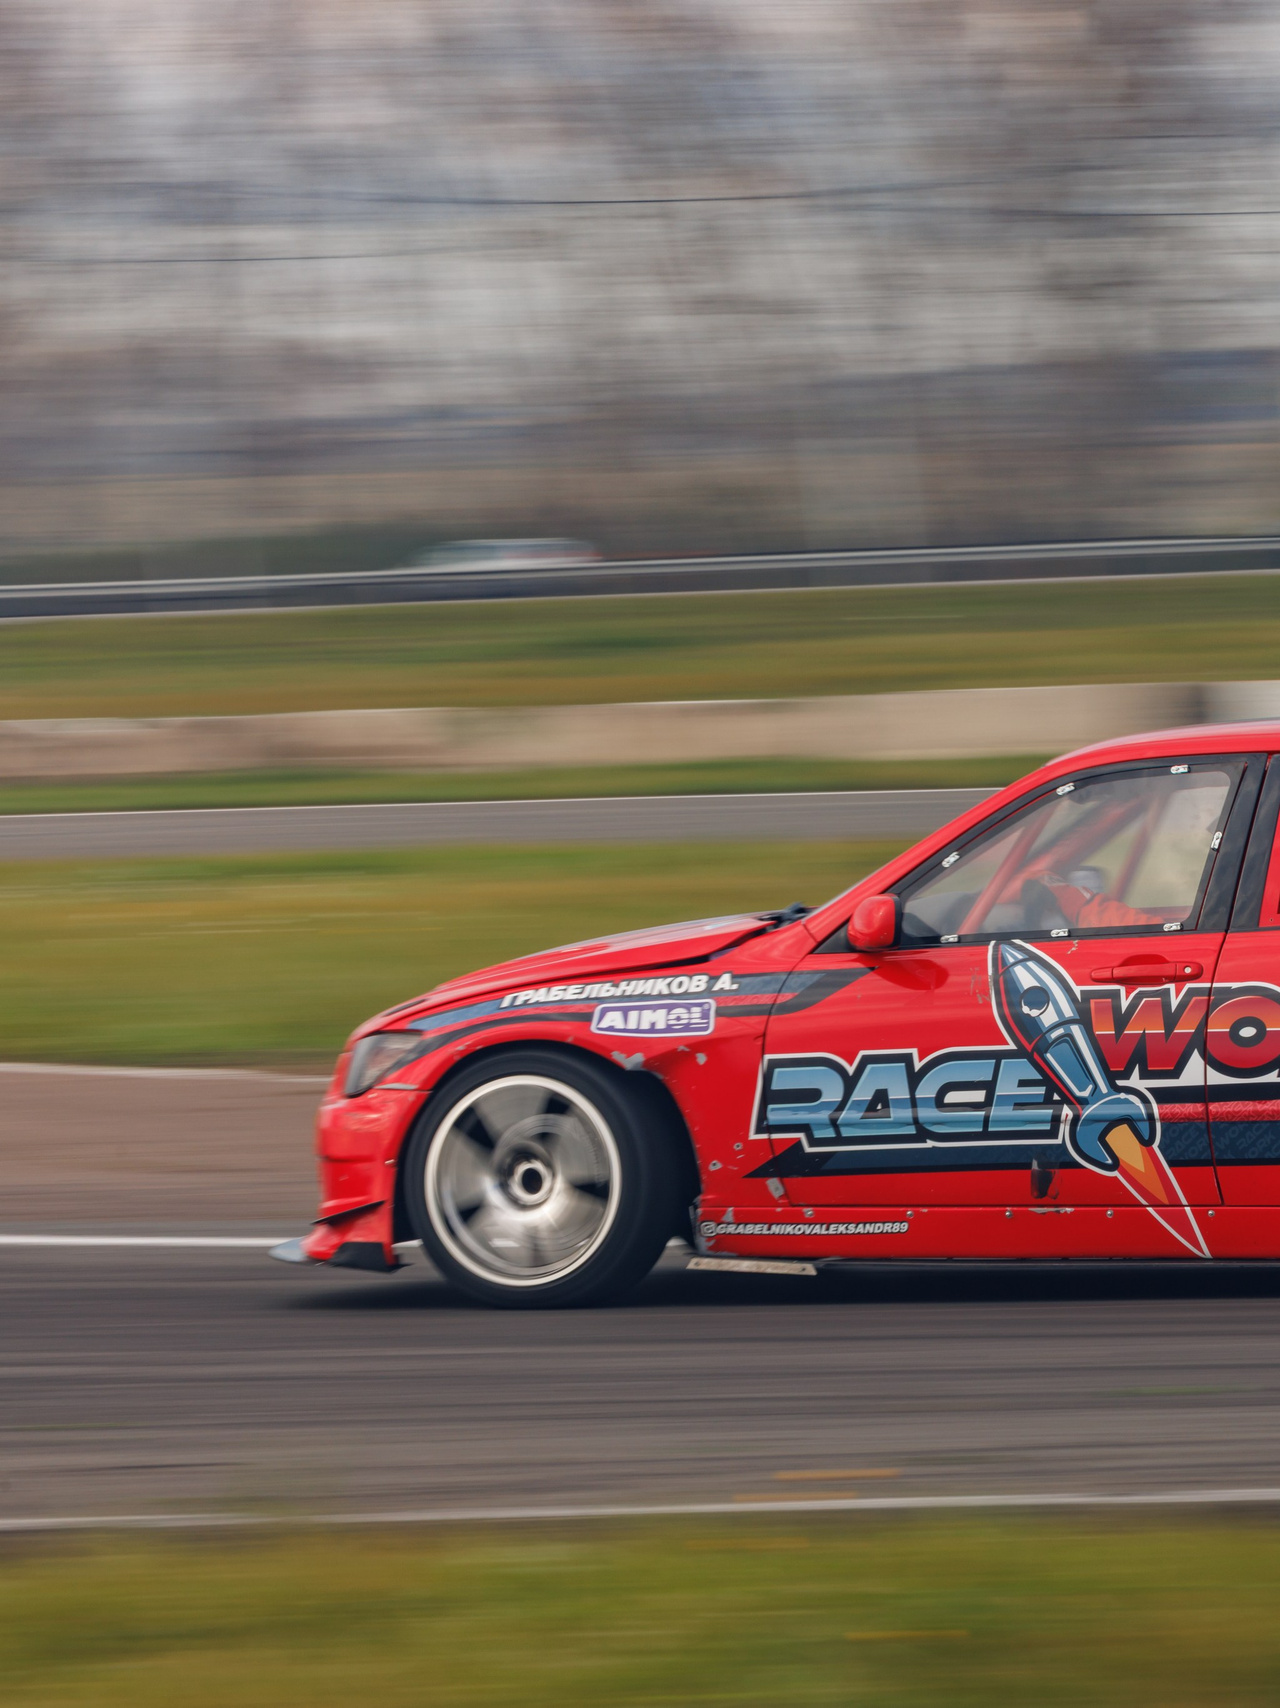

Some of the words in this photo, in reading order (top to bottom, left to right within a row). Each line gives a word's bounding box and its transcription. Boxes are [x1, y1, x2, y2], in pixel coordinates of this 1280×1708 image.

[499, 974, 709, 1008] ГРАБЕЛЬНИКОВ
[597, 1006, 709, 1029] AIMOL
[765, 1057, 1055, 1138] RACE
